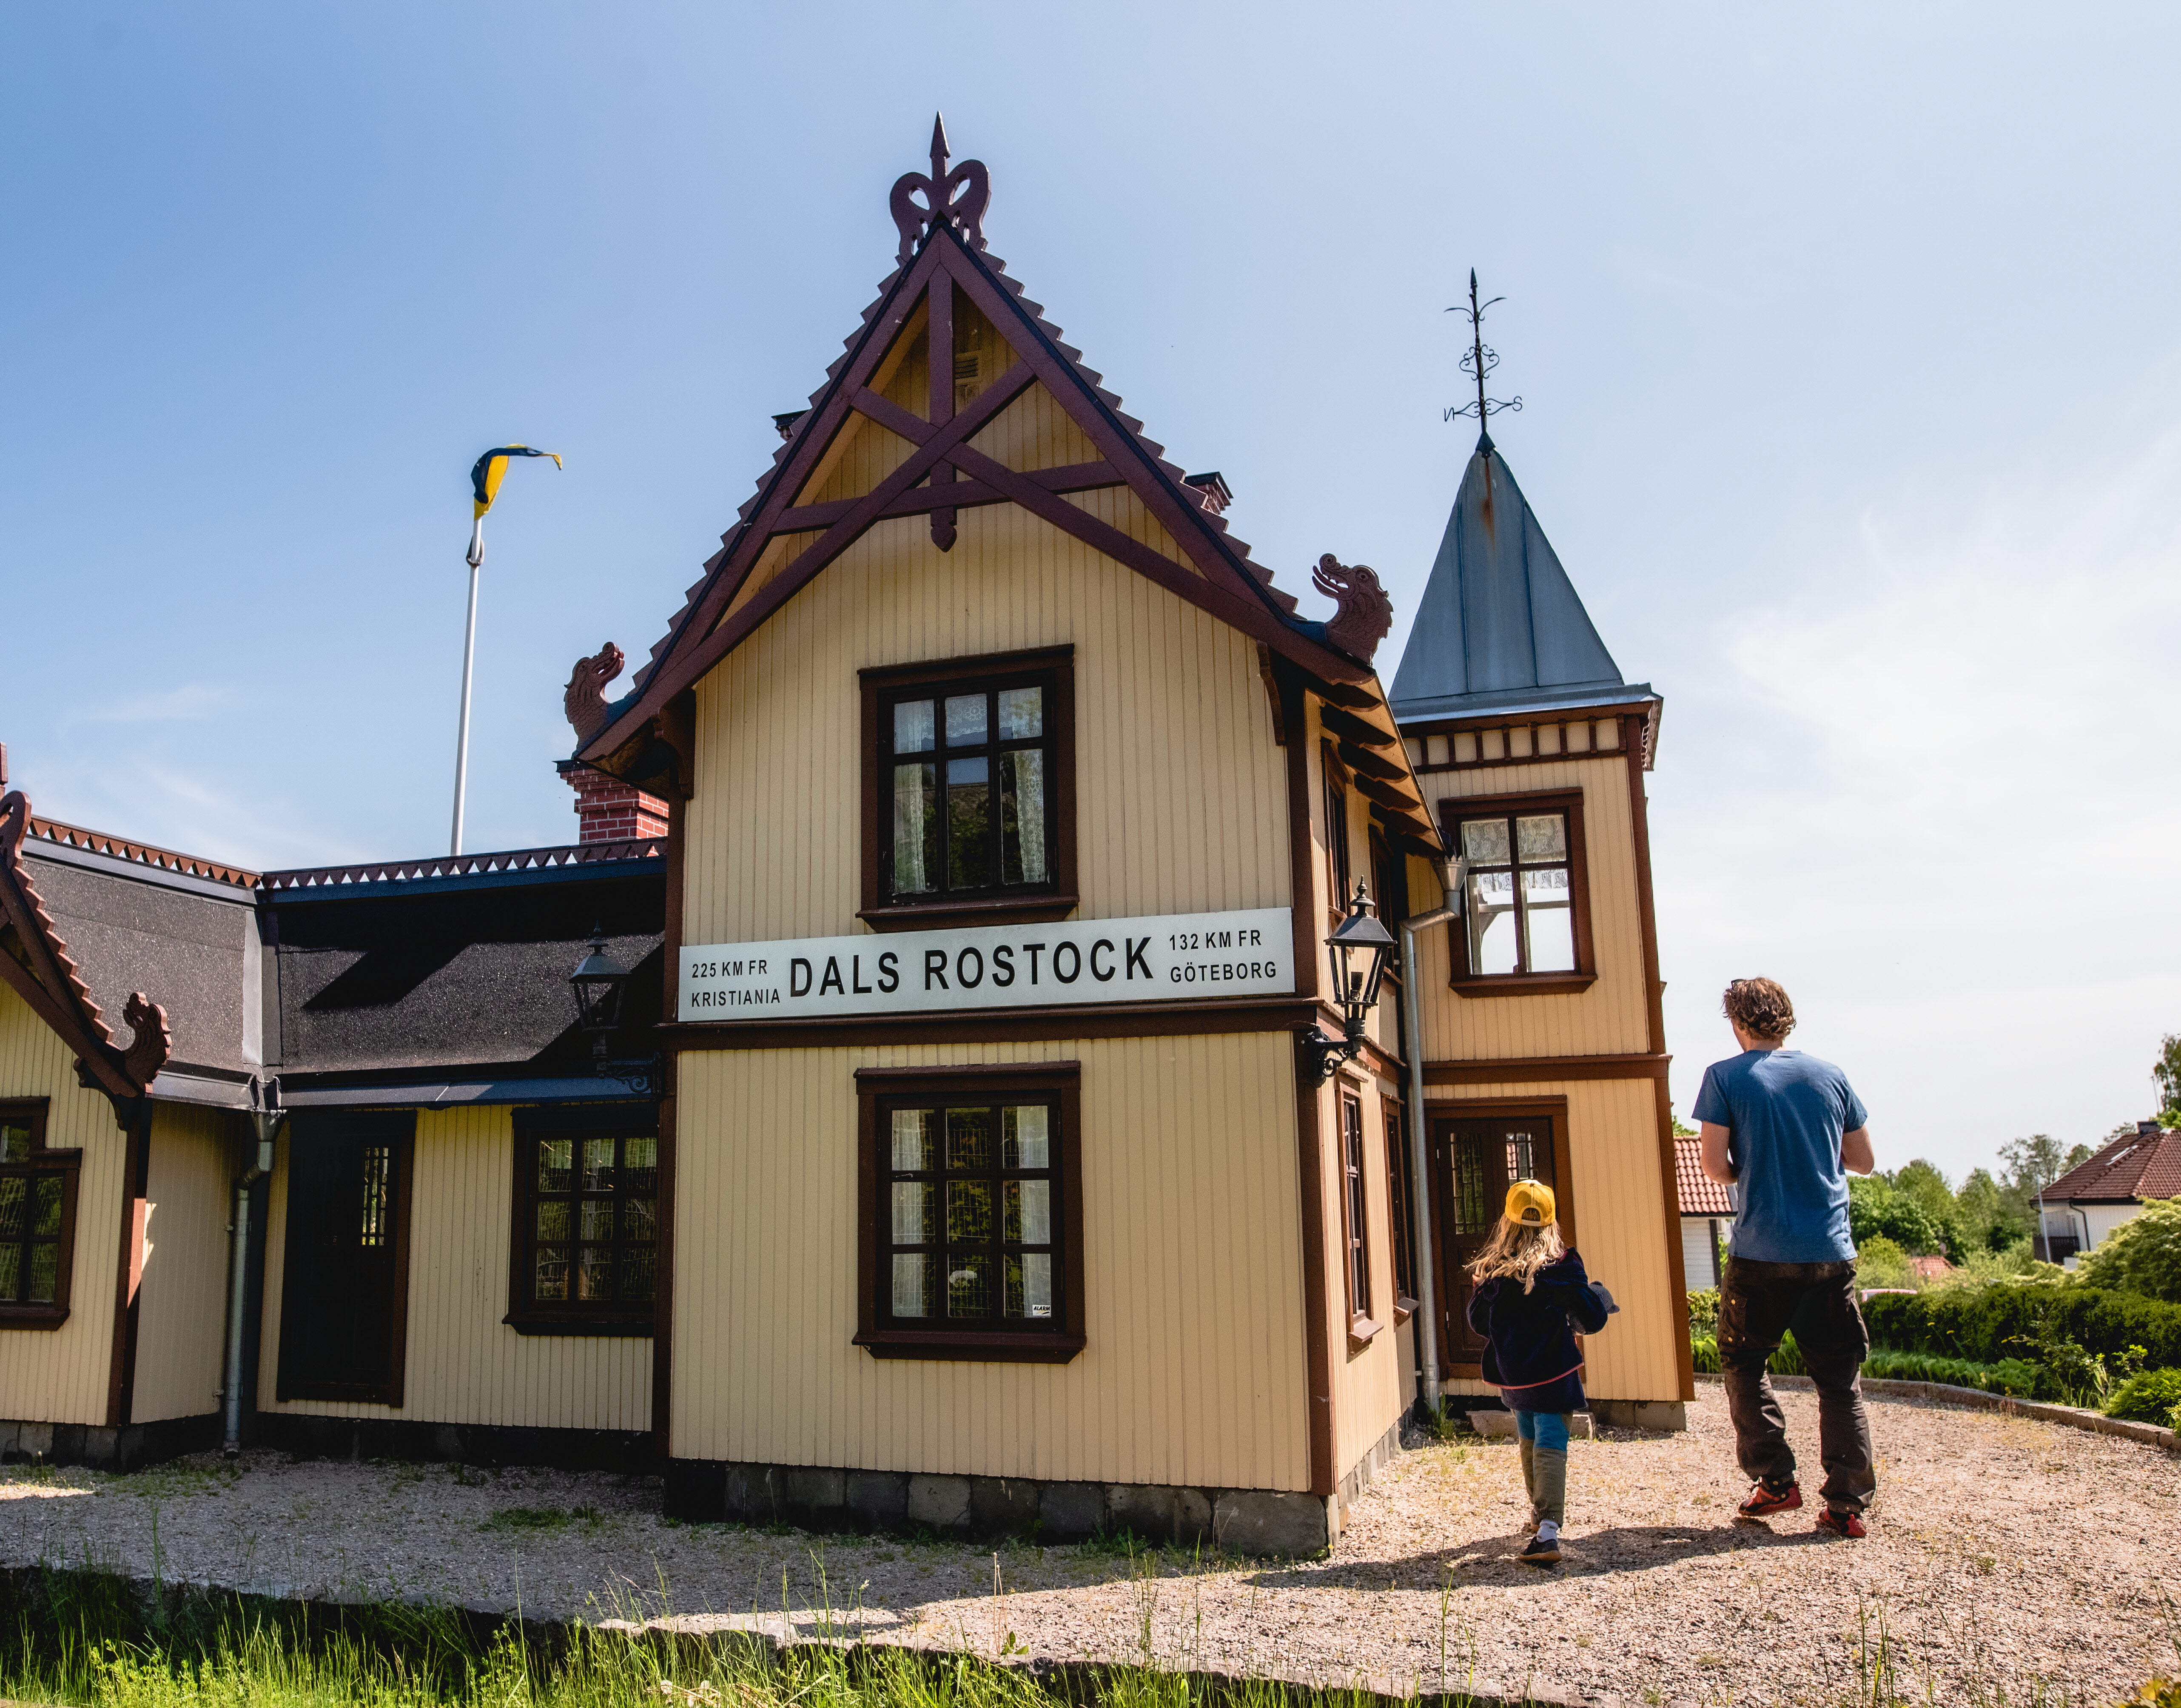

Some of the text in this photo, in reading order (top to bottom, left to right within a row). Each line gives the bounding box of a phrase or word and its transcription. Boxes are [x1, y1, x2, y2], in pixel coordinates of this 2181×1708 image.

[1170, 930, 1261, 951] 132 KM FR
[692, 959, 767, 978] 225 KM FR
[790, 937, 1153, 997] DALS ROSTOCK
[1170, 961, 1276, 983] GÖTEBORG
[692, 988, 780, 1008] KRISTIANIA
